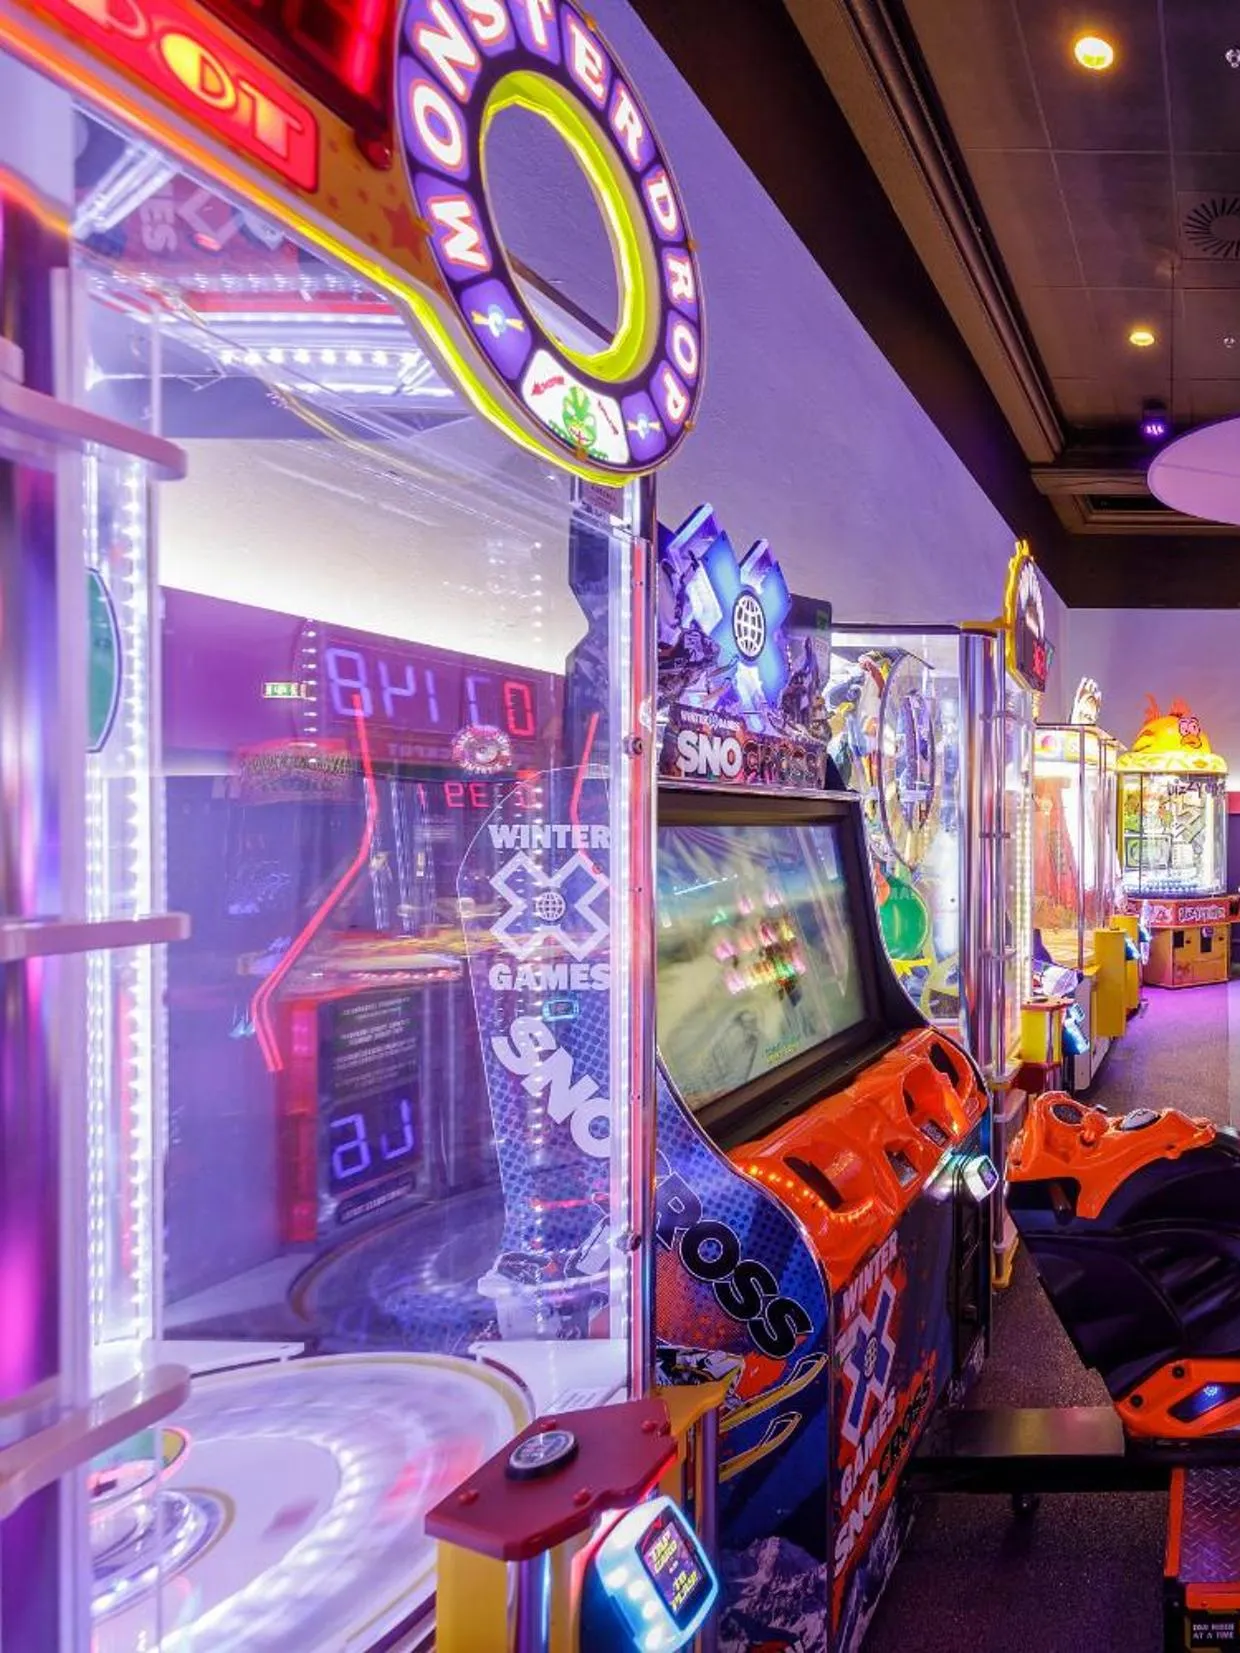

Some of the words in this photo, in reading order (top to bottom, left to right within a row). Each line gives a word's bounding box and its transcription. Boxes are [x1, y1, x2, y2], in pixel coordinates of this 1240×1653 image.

[645, 168, 699, 425] DROP
[676, 730, 742, 777] SNO
[488, 824, 611, 849] WINTER
[488, 963, 611, 991] GAMES
[490, 1016, 611, 1159] SNO
[655, 1148, 814, 1360] ROSS
[842, 1230, 899, 1319] WINTER
[834, 1468, 879, 1577] SNO
